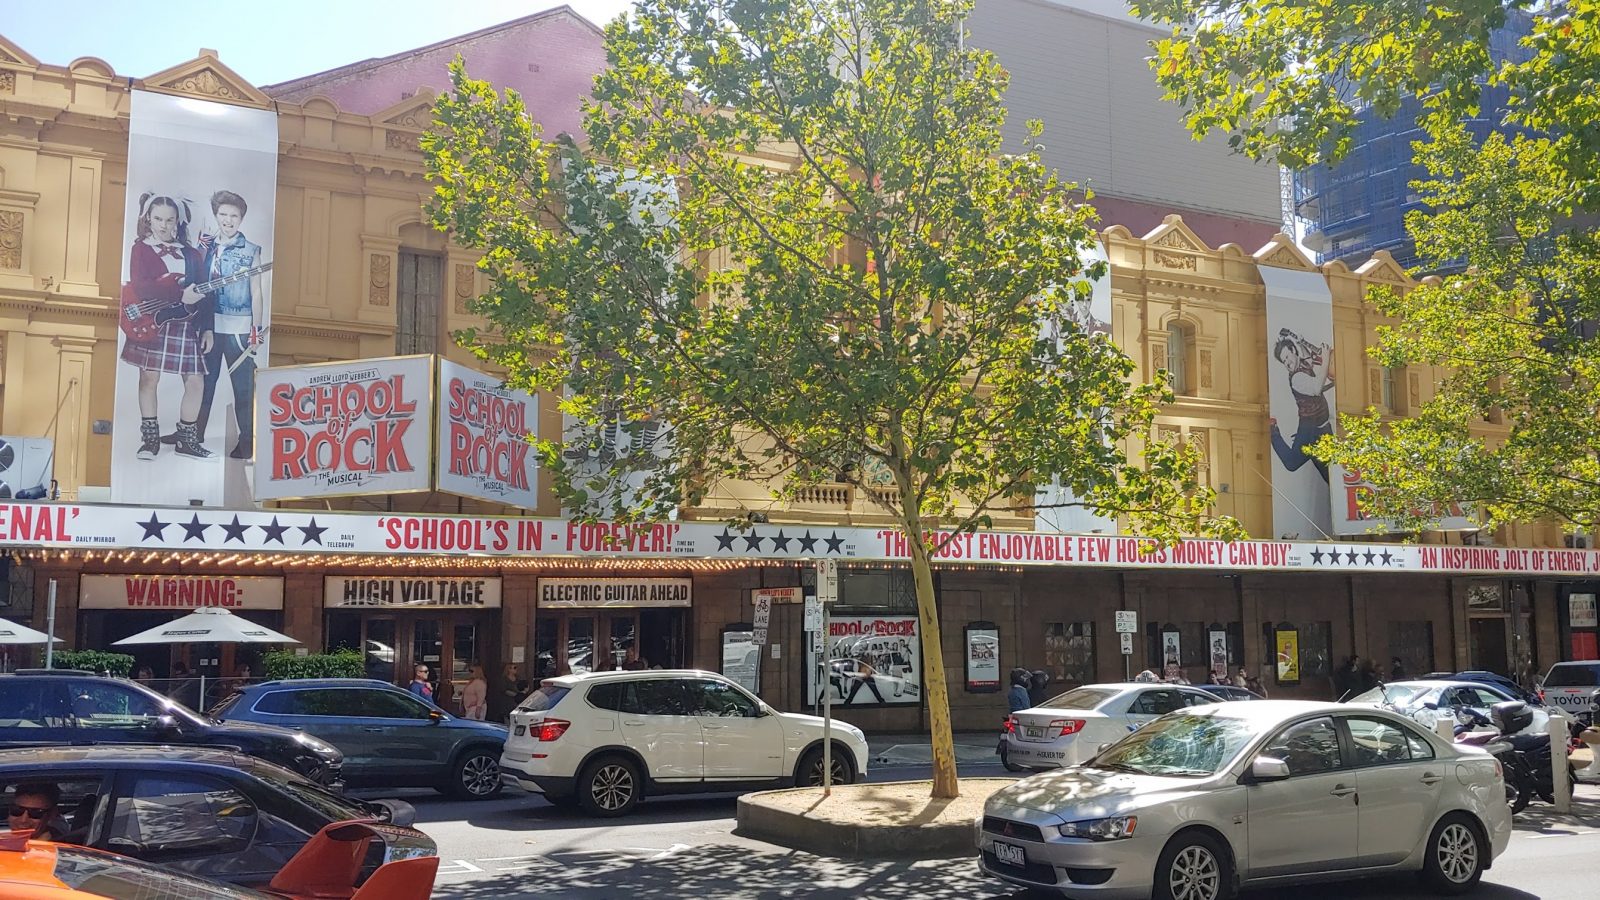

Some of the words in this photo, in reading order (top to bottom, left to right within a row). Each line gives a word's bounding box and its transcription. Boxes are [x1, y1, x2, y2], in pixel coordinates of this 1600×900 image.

[310, 375, 331, 384] ANDREW
[332, 373, 349, 383] LLOYD
[349, 371, 376, 381] WEBBER'S
[270, 374, 417, 425] SCHOOL
[449, 377, 531, 439] SCHOOL
[327, 410, 356, 445] of
[485, 424, 499, 450] of
[270, 419, 415, 481] ROCK
[448, 421, 530, 491] ROCK
[318, 472, 331, 480] THE
[327, 472, 363, 486] MUSICAL
[483, 483, 504, 491] MUSICAL
[377, 517, 509, 551] 'SCHOOL'S
[517, 520, 543, 552] IN
[876, 529, 912, 558] 'TH
[978, 533, 1073, 562] ENJOYABLE
[1077, 537, 1111, 562] FEW
[1171, 540, 1224, 565] MONEY
[1228, 542, 1258, 565] CAN
[1261, 543, 1292, 567] BUY'
[1418, 547, 1437, 568] 'AN
[1441, 547, 1500, 570] INSPIRING
[1503, 549, 1528, 571] JOLT
[1532, 550, 1545, 571] OF
[1548, 550, 1590, 572] ENERGY,
[126, 577, 242, 607] WARNING:
[344, 579, 394, 606] HIGH
[401, 580, 485, 606] VOLTAGE
[542, 584, 602, 602] ELECTRIC
[604, 584, 648, 601] GUITAR
[650, 584, 688, 601] AHEAD
[755, 615, 768, 624] LANE
[829, 621, 865, 636] HOOL
[874, 620, 917, 637] ROCK
